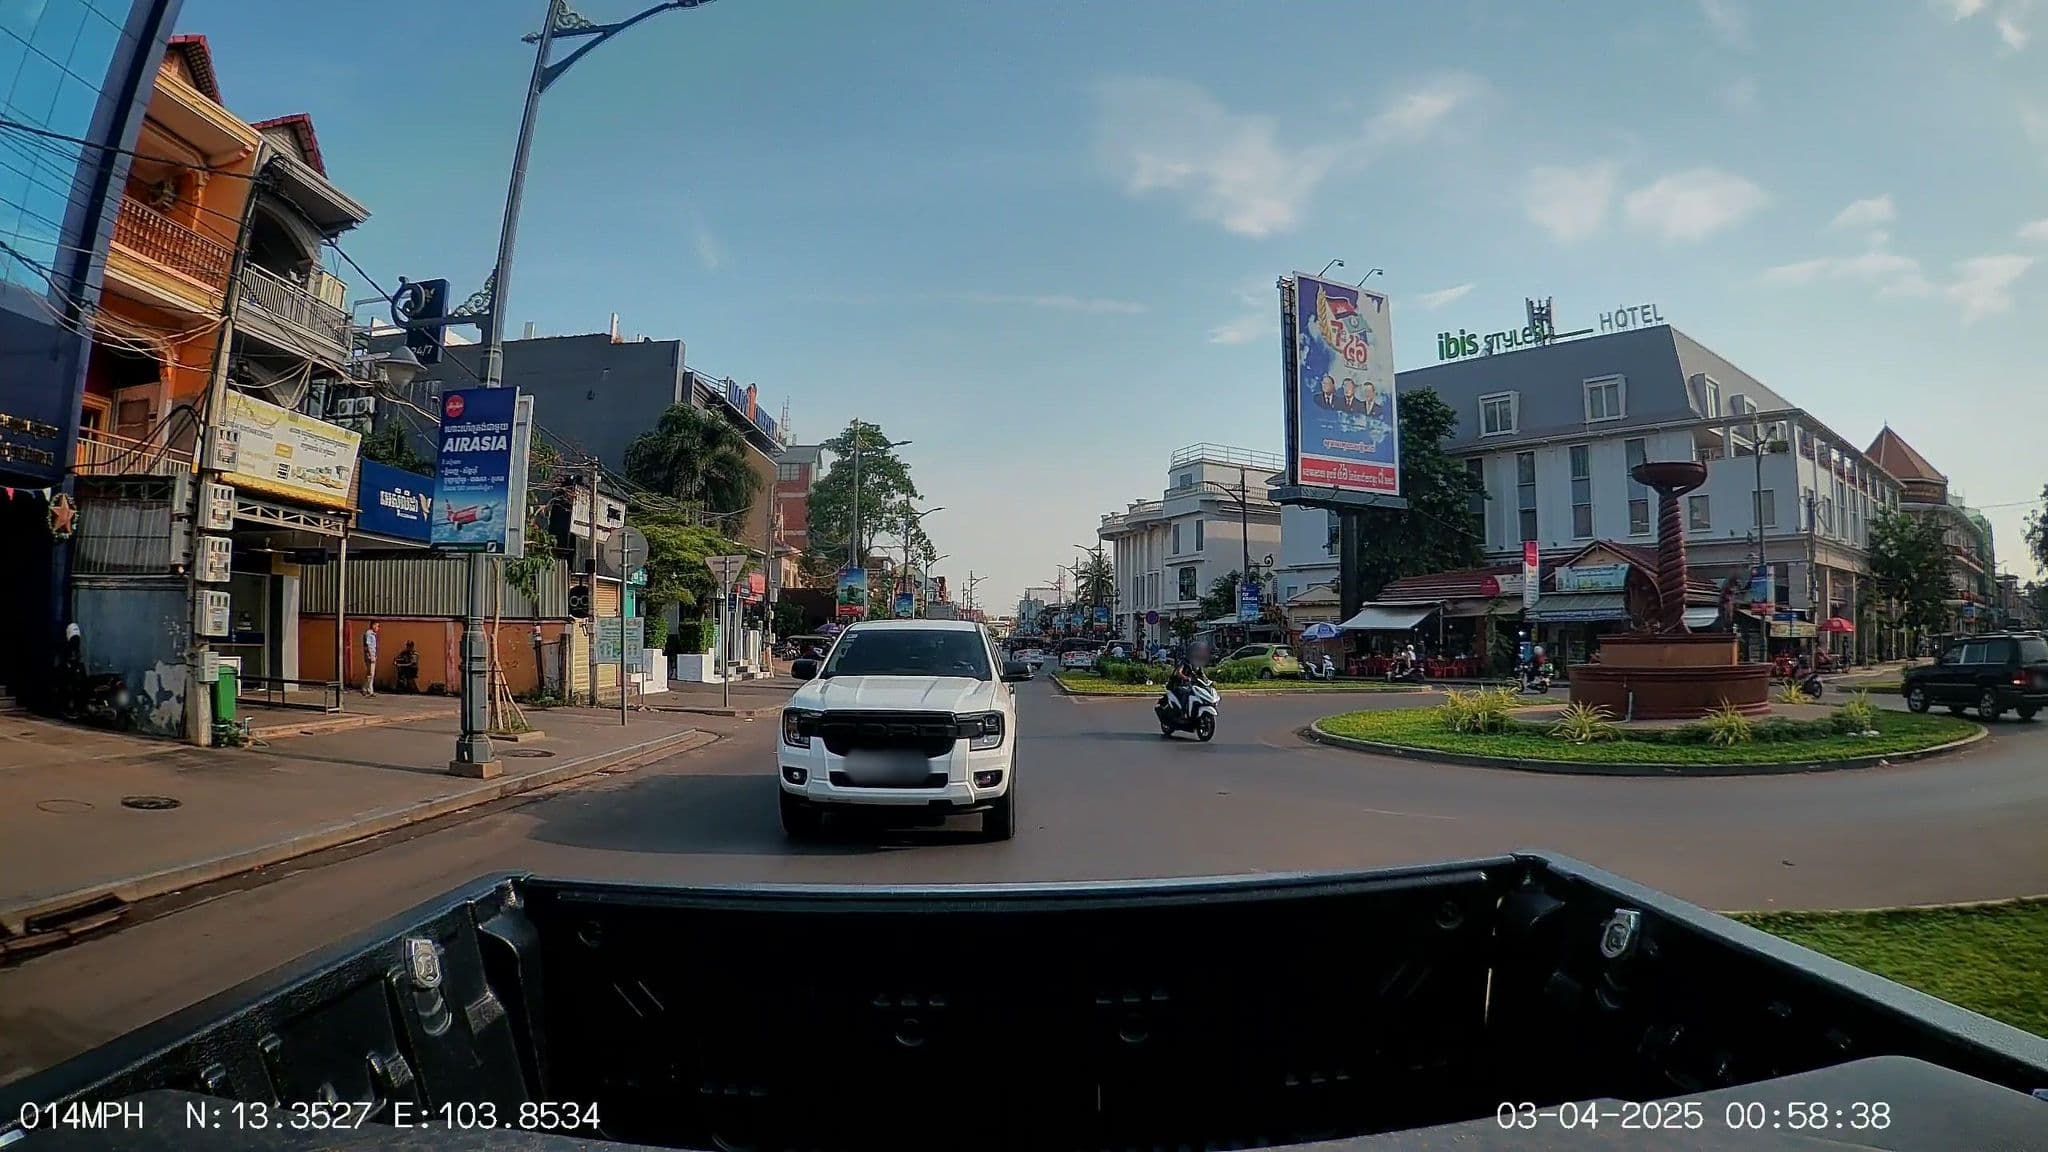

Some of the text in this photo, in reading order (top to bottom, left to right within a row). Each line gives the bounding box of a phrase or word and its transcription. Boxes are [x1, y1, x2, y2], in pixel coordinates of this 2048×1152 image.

[1437, 328, 1479, 360] ibis
[1600, 303, 1664, 331] HOTEL
[442, 435, 507, 452] AIRASIA
